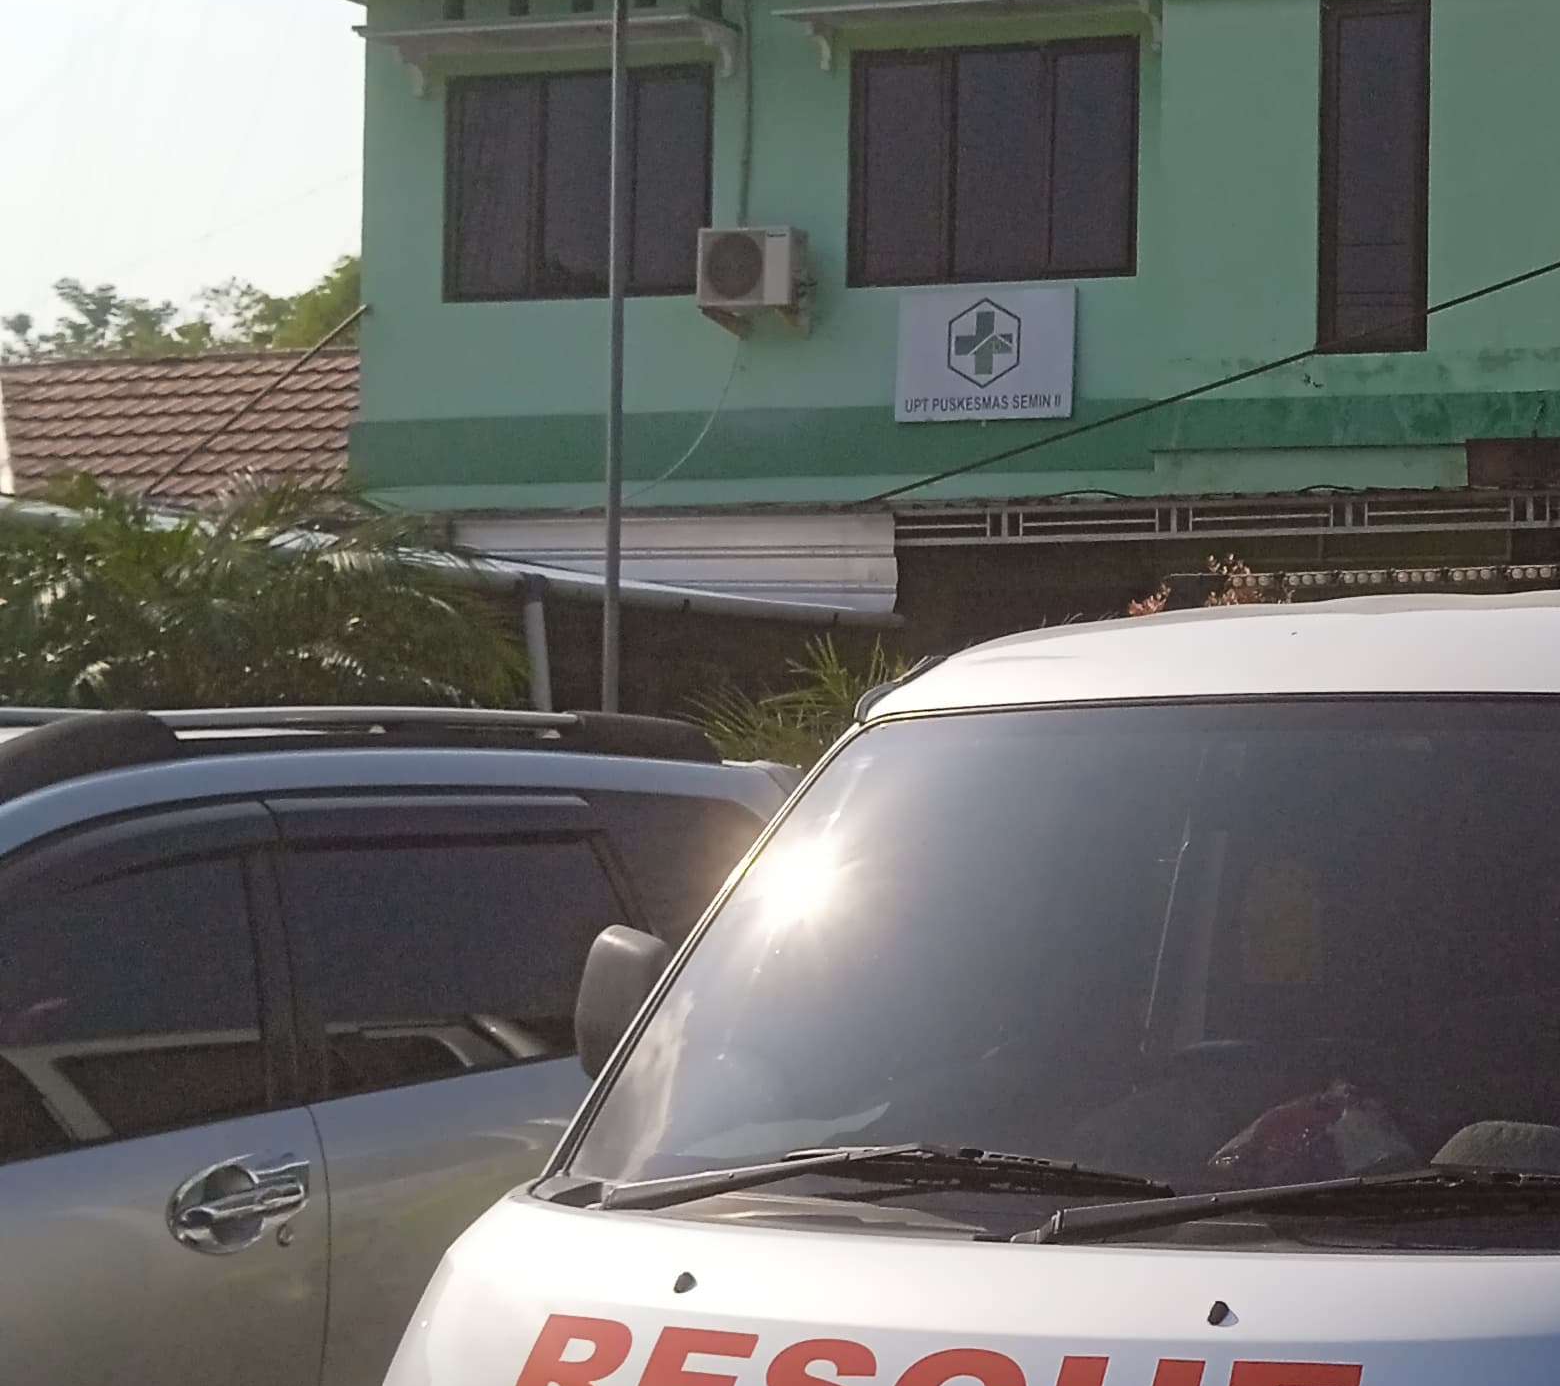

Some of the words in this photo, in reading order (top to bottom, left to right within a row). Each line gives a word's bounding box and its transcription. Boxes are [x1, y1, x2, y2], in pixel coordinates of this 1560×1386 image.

[905, 397, 929, 413] UPT
[932, 394, 1009, 412] PUSKESMAS
[1012, 393, 1051, 410] SEMIN
